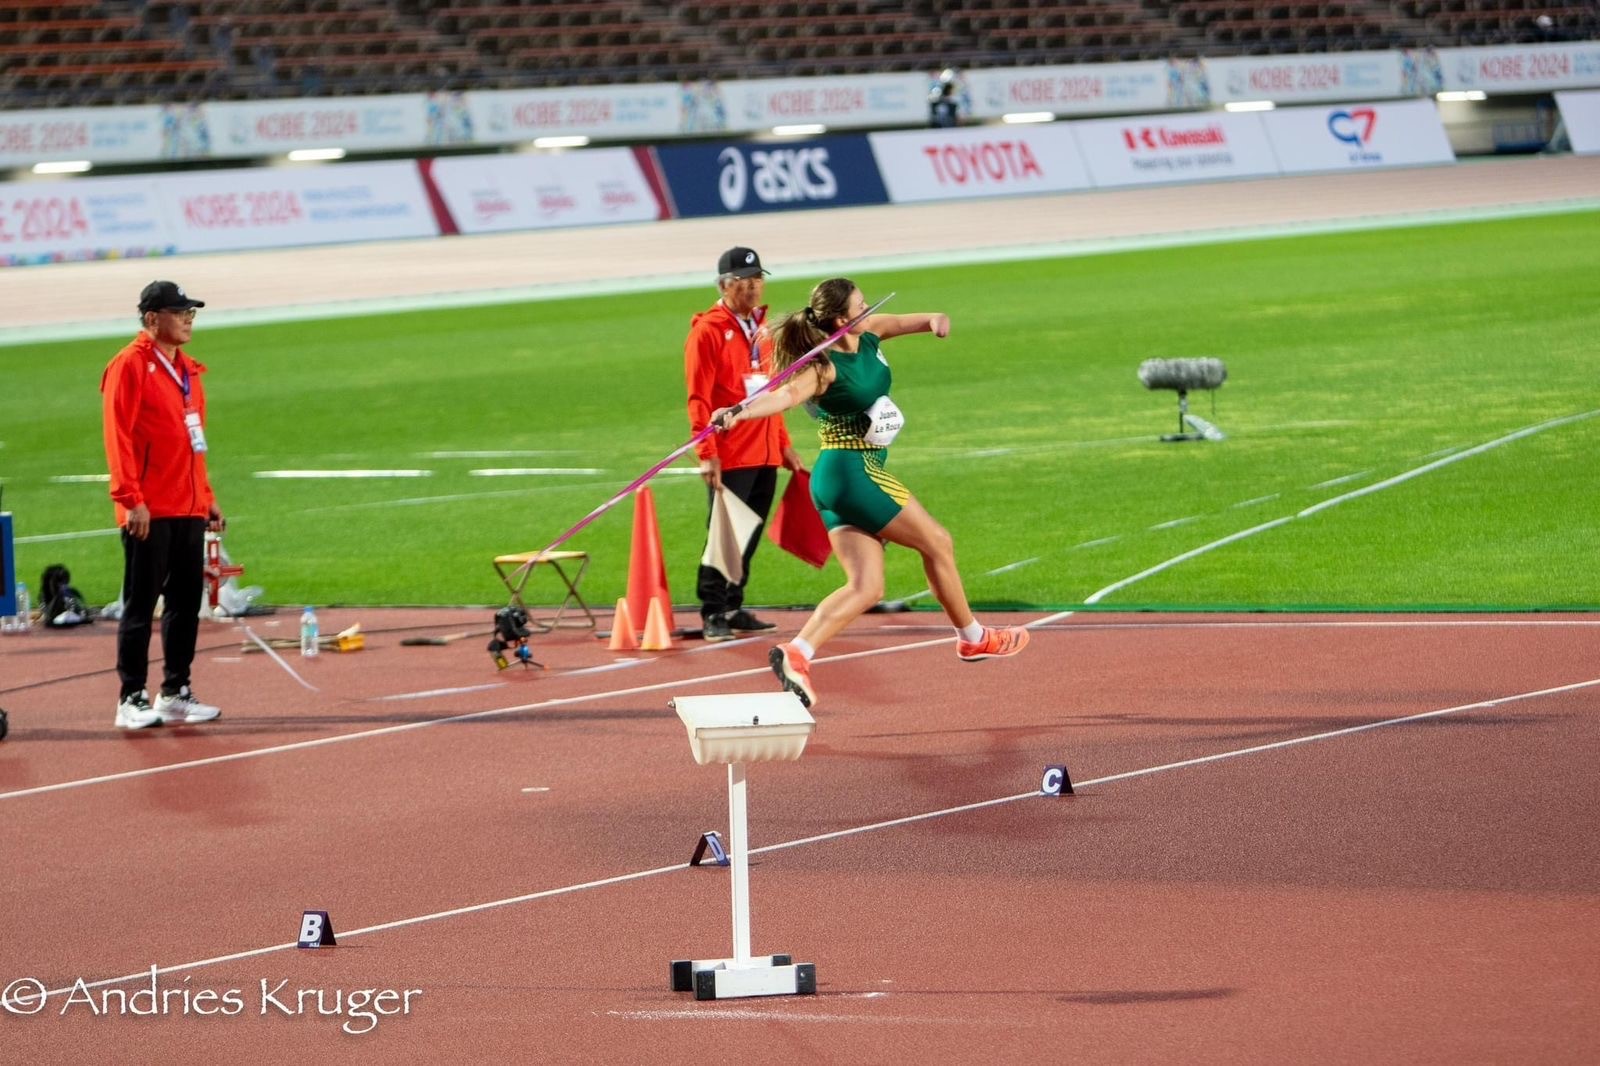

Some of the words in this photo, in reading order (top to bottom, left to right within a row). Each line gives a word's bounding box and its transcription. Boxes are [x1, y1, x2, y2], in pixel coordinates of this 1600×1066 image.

[1299, 63, 1341, 89] 2024
[1480, 55, 1523, 80] KOBE
[1527, 53, 1570, 79] 2024
[1060, 77, 1104, 103] 2024
[310, 109, 358, 139] 2024
[922, 140, 1044, 184] TOYOTA
[12, 196, 88, 242] 2024
[244, 189, 302, 226] 2024
[1042, 768, 1062, 793] C
[705, 835, 726, 862] D
[299, 914, 322, 942] B
